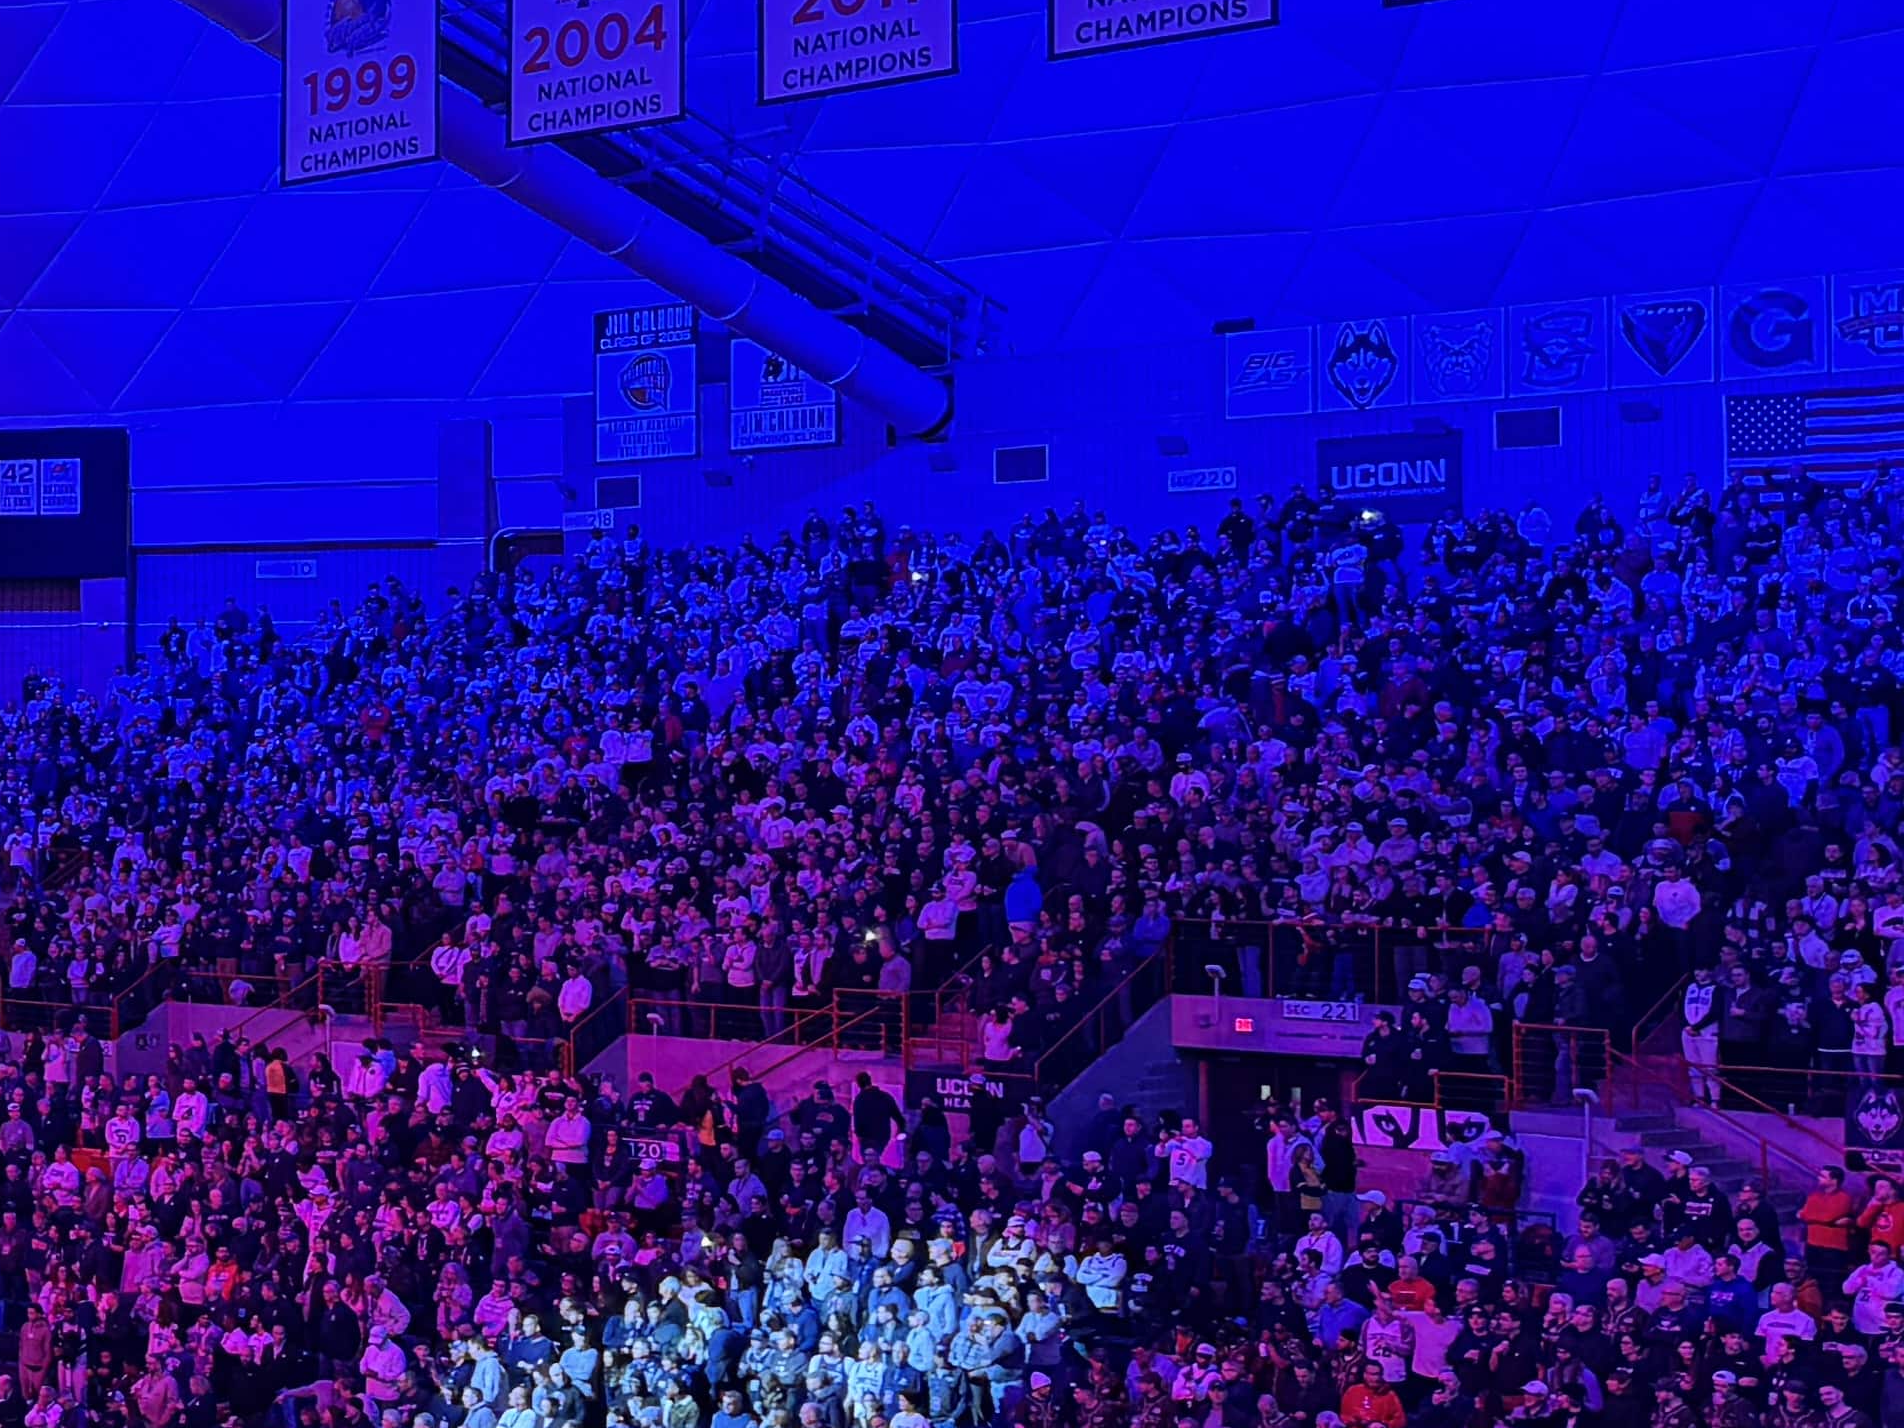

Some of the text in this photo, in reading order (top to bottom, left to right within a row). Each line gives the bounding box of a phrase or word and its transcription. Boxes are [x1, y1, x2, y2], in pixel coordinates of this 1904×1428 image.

[522, 4, 668, 74] 2004
[793, 18, 921, 58] NATIONAL
[303, 54, 418, 116] 1999
[538, 67, 652, 101] NATIONAL
[782, 46, 932, 90] CHAMPIONS
[308, 111, 411, 145] NATIONAL
[528, 93, 662, 133] CHAMPIONS
[301, 135, 421, 173] CHAMPIONS
[2, 463, 34, 483] 42
[1330, 458, 1445, 490] UCONN
[1321, 1003, 1356, 1020] 221
[629, 1142, 661, 1160] 120
